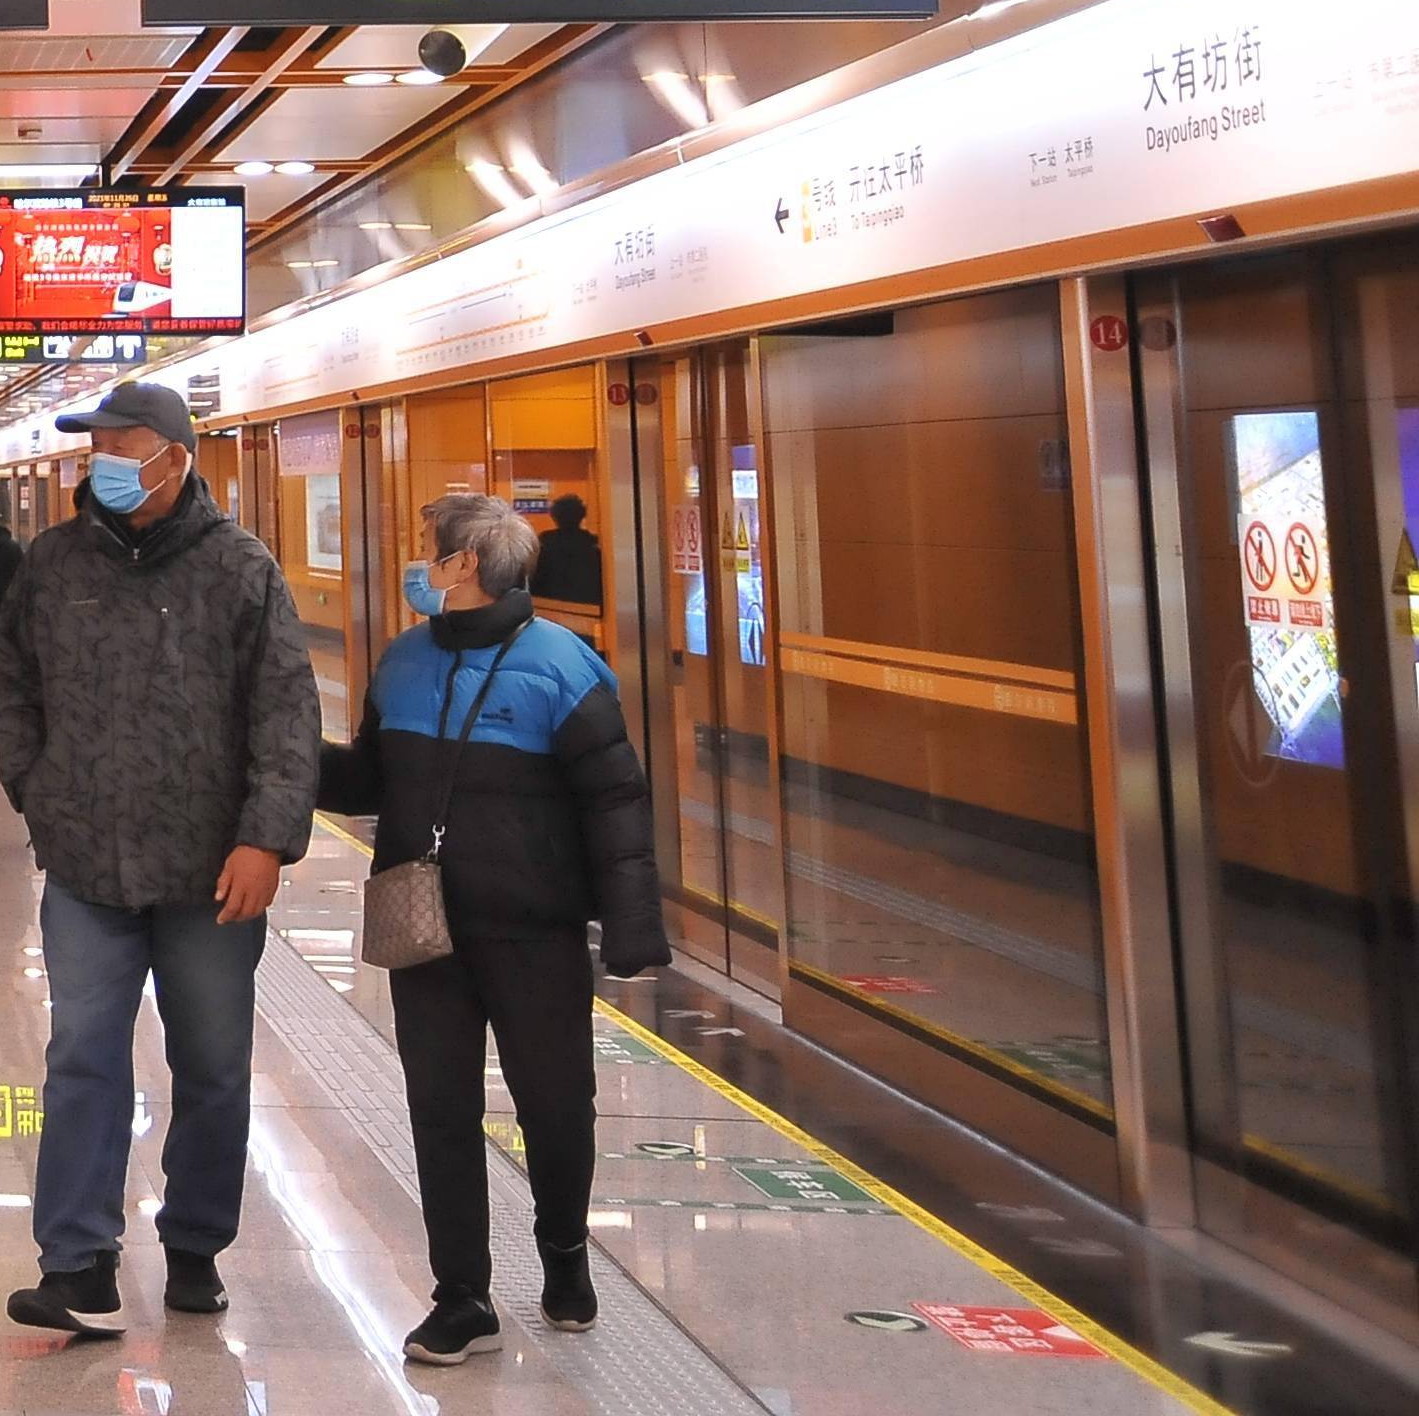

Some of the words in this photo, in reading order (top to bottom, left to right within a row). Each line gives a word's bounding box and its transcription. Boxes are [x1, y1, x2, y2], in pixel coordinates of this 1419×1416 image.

[1142, 24, 1263, 112] 大有坊街
[1145, 113, 1218, 152] Dayoufang
[1220, 99, 1266, 133] Street
[1093, 321, 1123, 344] 14
